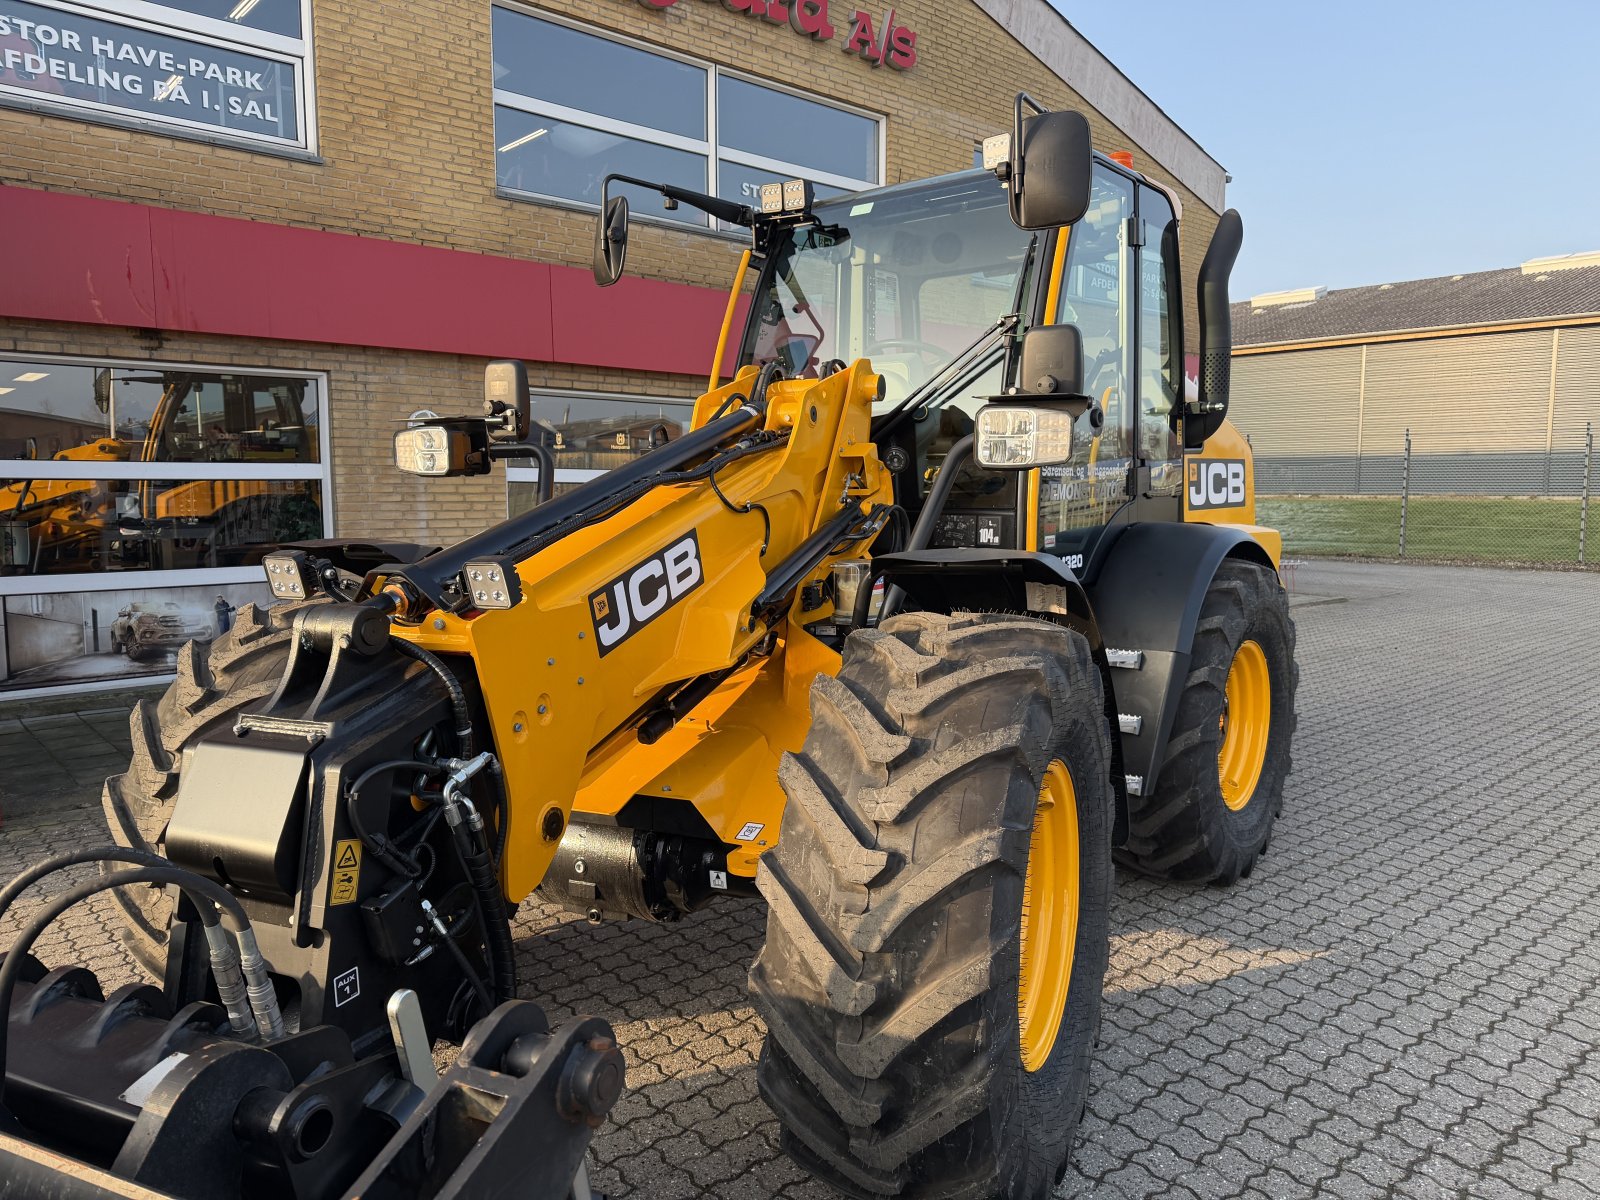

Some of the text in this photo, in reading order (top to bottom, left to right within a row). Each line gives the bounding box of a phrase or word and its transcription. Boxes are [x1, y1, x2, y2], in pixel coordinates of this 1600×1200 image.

[0, 15, 263, 91] STOR HAVE-PARK
[0, 48, 142, 94] FDELING
[228, 96, 278, 122] SAL
[742, 182, 762, 198] ST
[1041, 481, 1125, 501] DEMONATOR
[1189, 462, 1245, 506] JCB
[979, 528, 994, 543] 104
[1058, 553, 1083, 569] 320
[598, 537, 700, 647] JCB
[337, 974, 355, 988] AUX
[344, 985, 350, 994] 1
